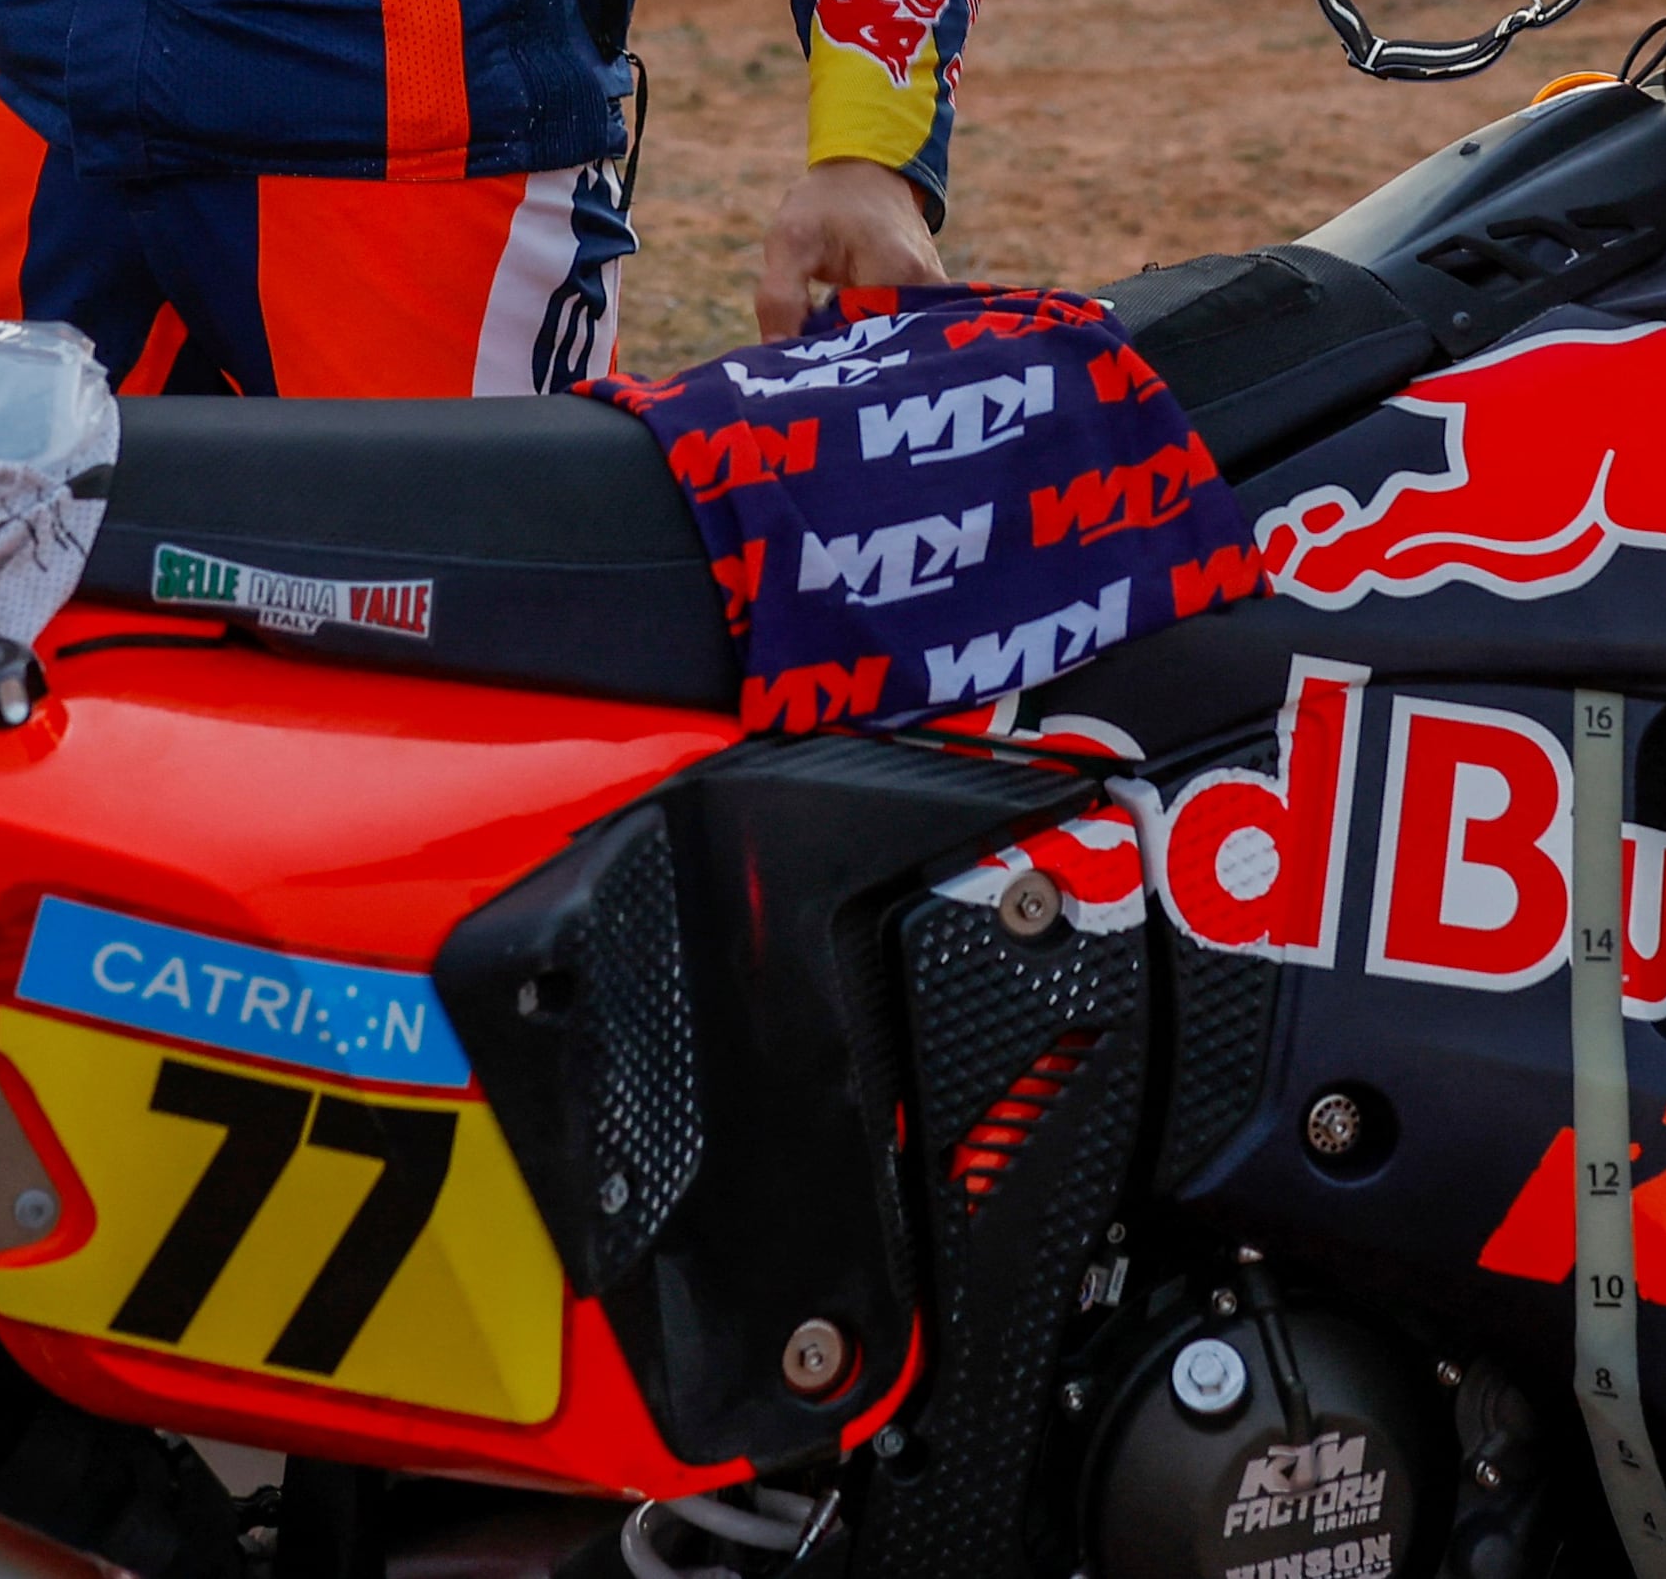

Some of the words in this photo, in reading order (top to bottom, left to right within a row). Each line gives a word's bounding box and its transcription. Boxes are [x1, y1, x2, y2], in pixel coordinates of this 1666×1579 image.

[858, 365, 1055, 467] KTM
[1030, 430, 1220, 547] KTM
[797, 502, 995, 608] KTM
[156, 547, 240, 601] SELLE
[350, 585, 429, 635] VALLE
[261, 610, 321, 631] ITALY
[923, 576, 1133, 707] KTM
[1584, 705, 1614, 732] 16
[1581, 928, 1615, 954] 14
[1586, 1161, 1620, 1188] 12
[107, 1057, 460, 1377] 77
[1589, 1274, 1624, 1300] 10
[1595, 1367, 1611, 1391] 8
[1222, 1469, 1387, 1539] FACTORY
